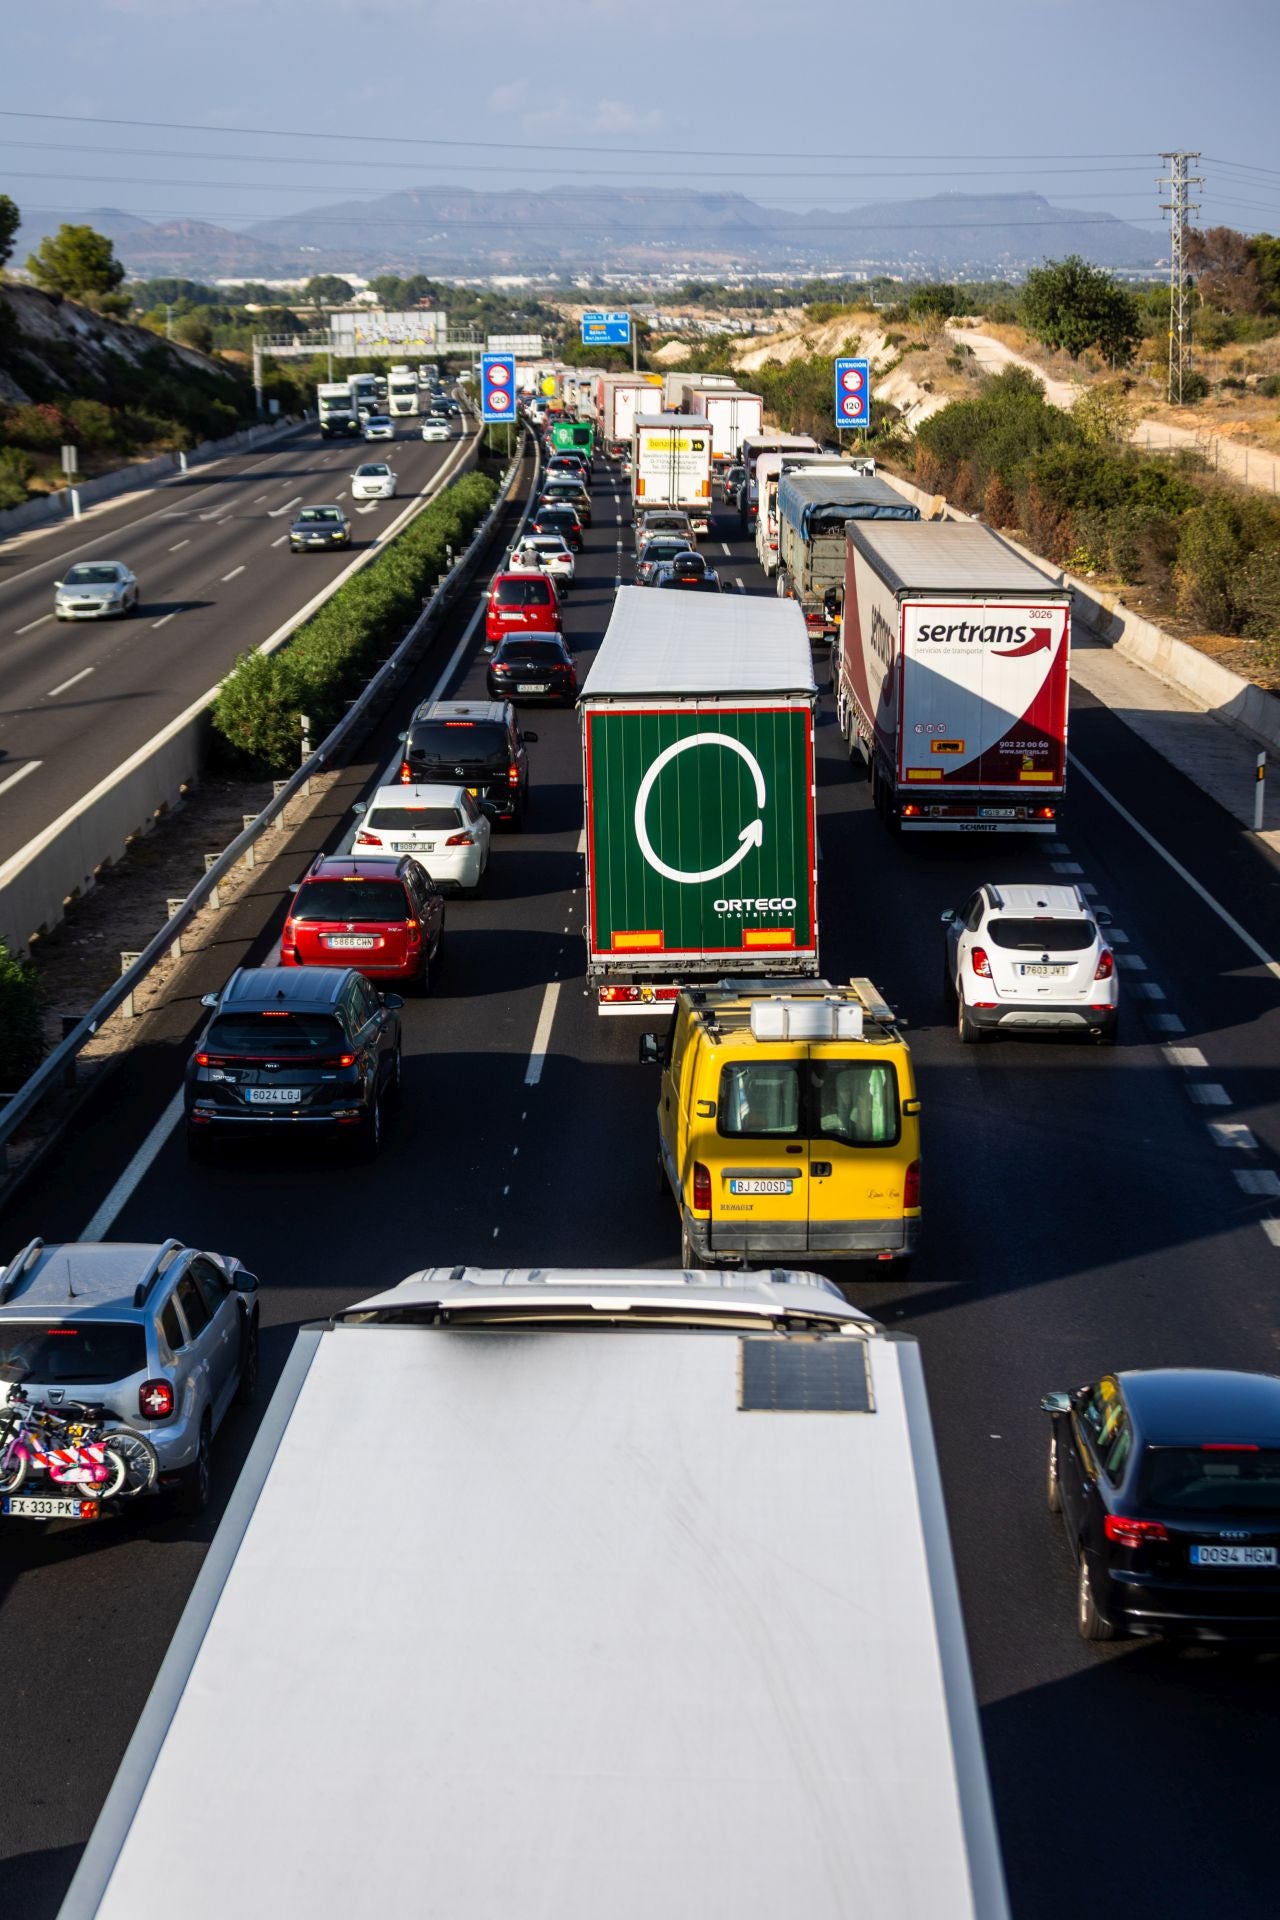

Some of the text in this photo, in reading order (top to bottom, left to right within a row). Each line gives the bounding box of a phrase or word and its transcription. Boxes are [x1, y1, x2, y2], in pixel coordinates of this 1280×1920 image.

[492, 396, 507, 404] 120
[846, 402, 860, 410] 120
[1029, 610, 1053, 619] 3026
[917, 621, 1027, 643] sertrans
[952, 647, 983, 656] transporte
[999, 740, 1015, 748] 902
[1038, 740, 1049, 748] 60
[713, 897, 797, 912] ORTEGO
[334, 938, 355, 946] 5866
[1026, 966, 1048, 975] 7603
[253, 1090, 300, 1100] 6024 LGJ
[737, 1181, 750, 1192] BJ
[11, 1500, 72, 1514] FX-333-PK
[1200, 1547, 1239, 1562] 0094
